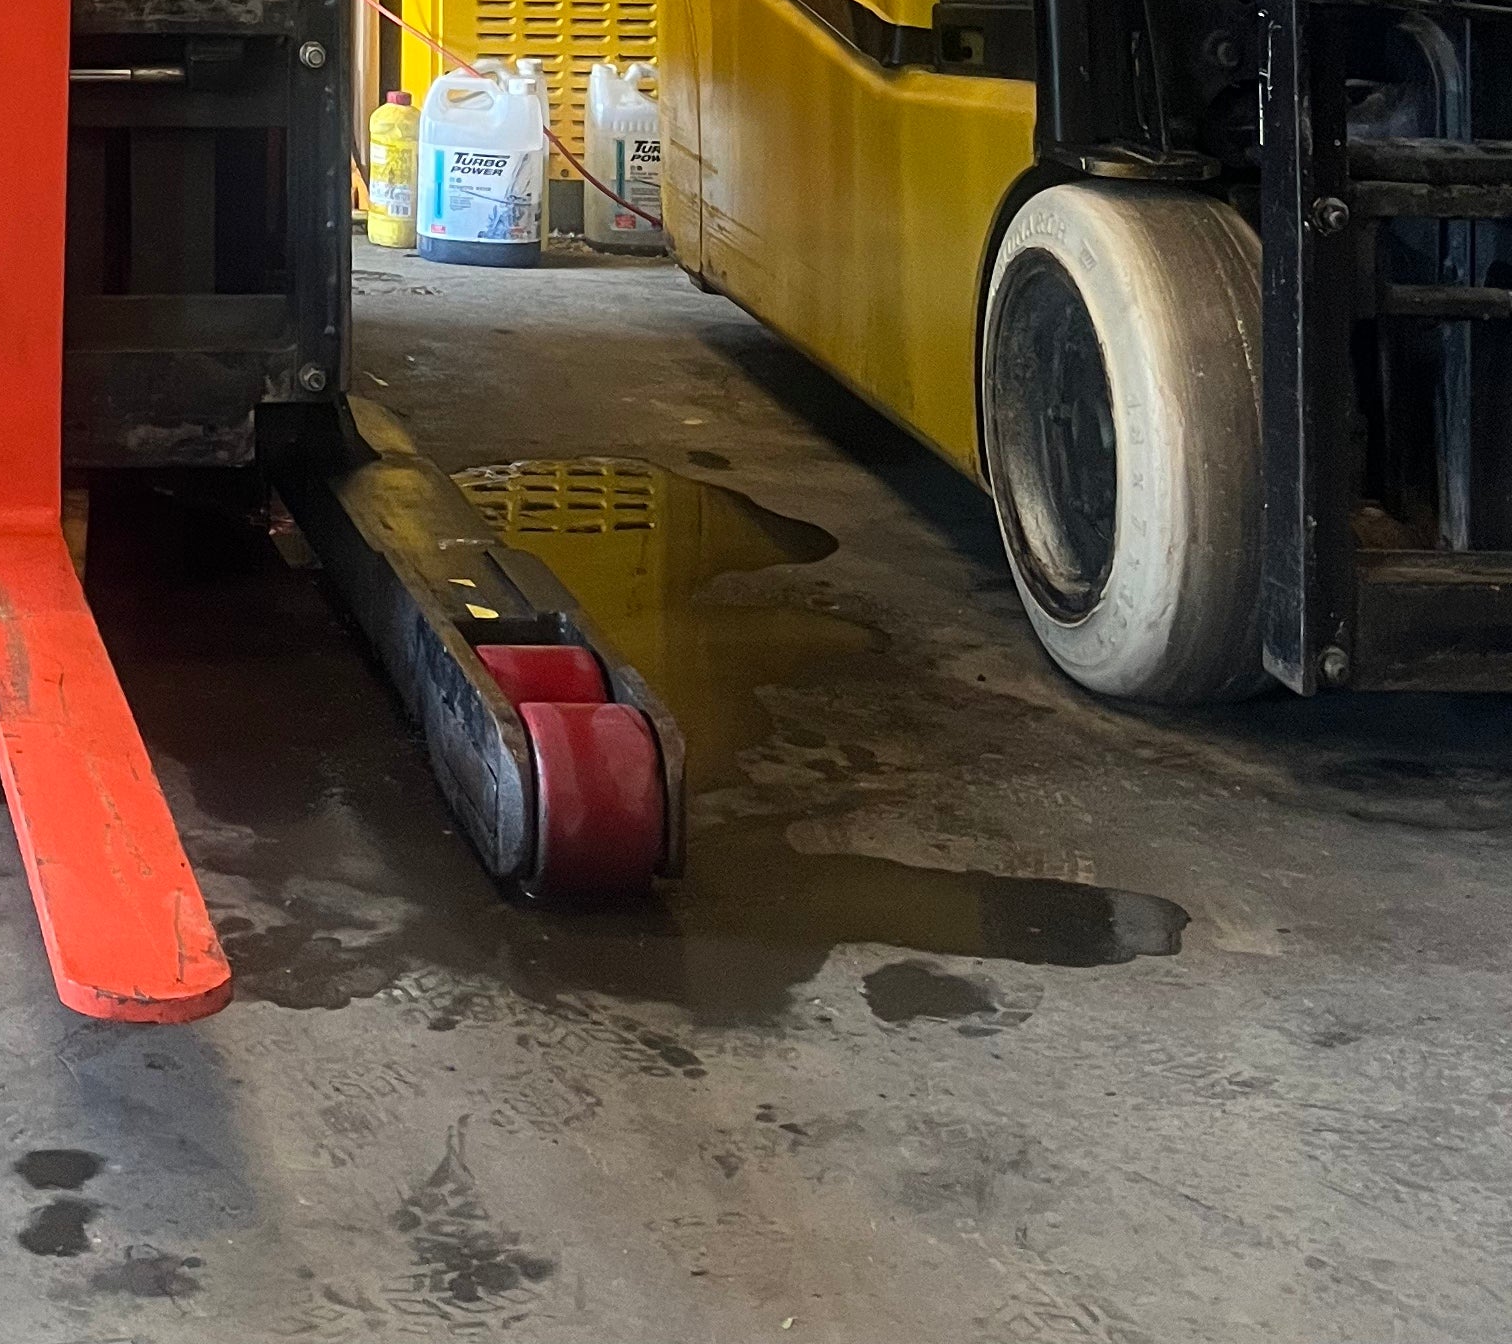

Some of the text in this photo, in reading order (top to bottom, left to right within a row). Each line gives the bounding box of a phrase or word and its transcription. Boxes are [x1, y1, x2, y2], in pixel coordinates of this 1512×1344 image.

[634, 140, 661, 154] TUR
[454, 152, 510, 167] TURBO
[630, 154, 661, 162] POW
[451, 165, 503, 177] POWER
